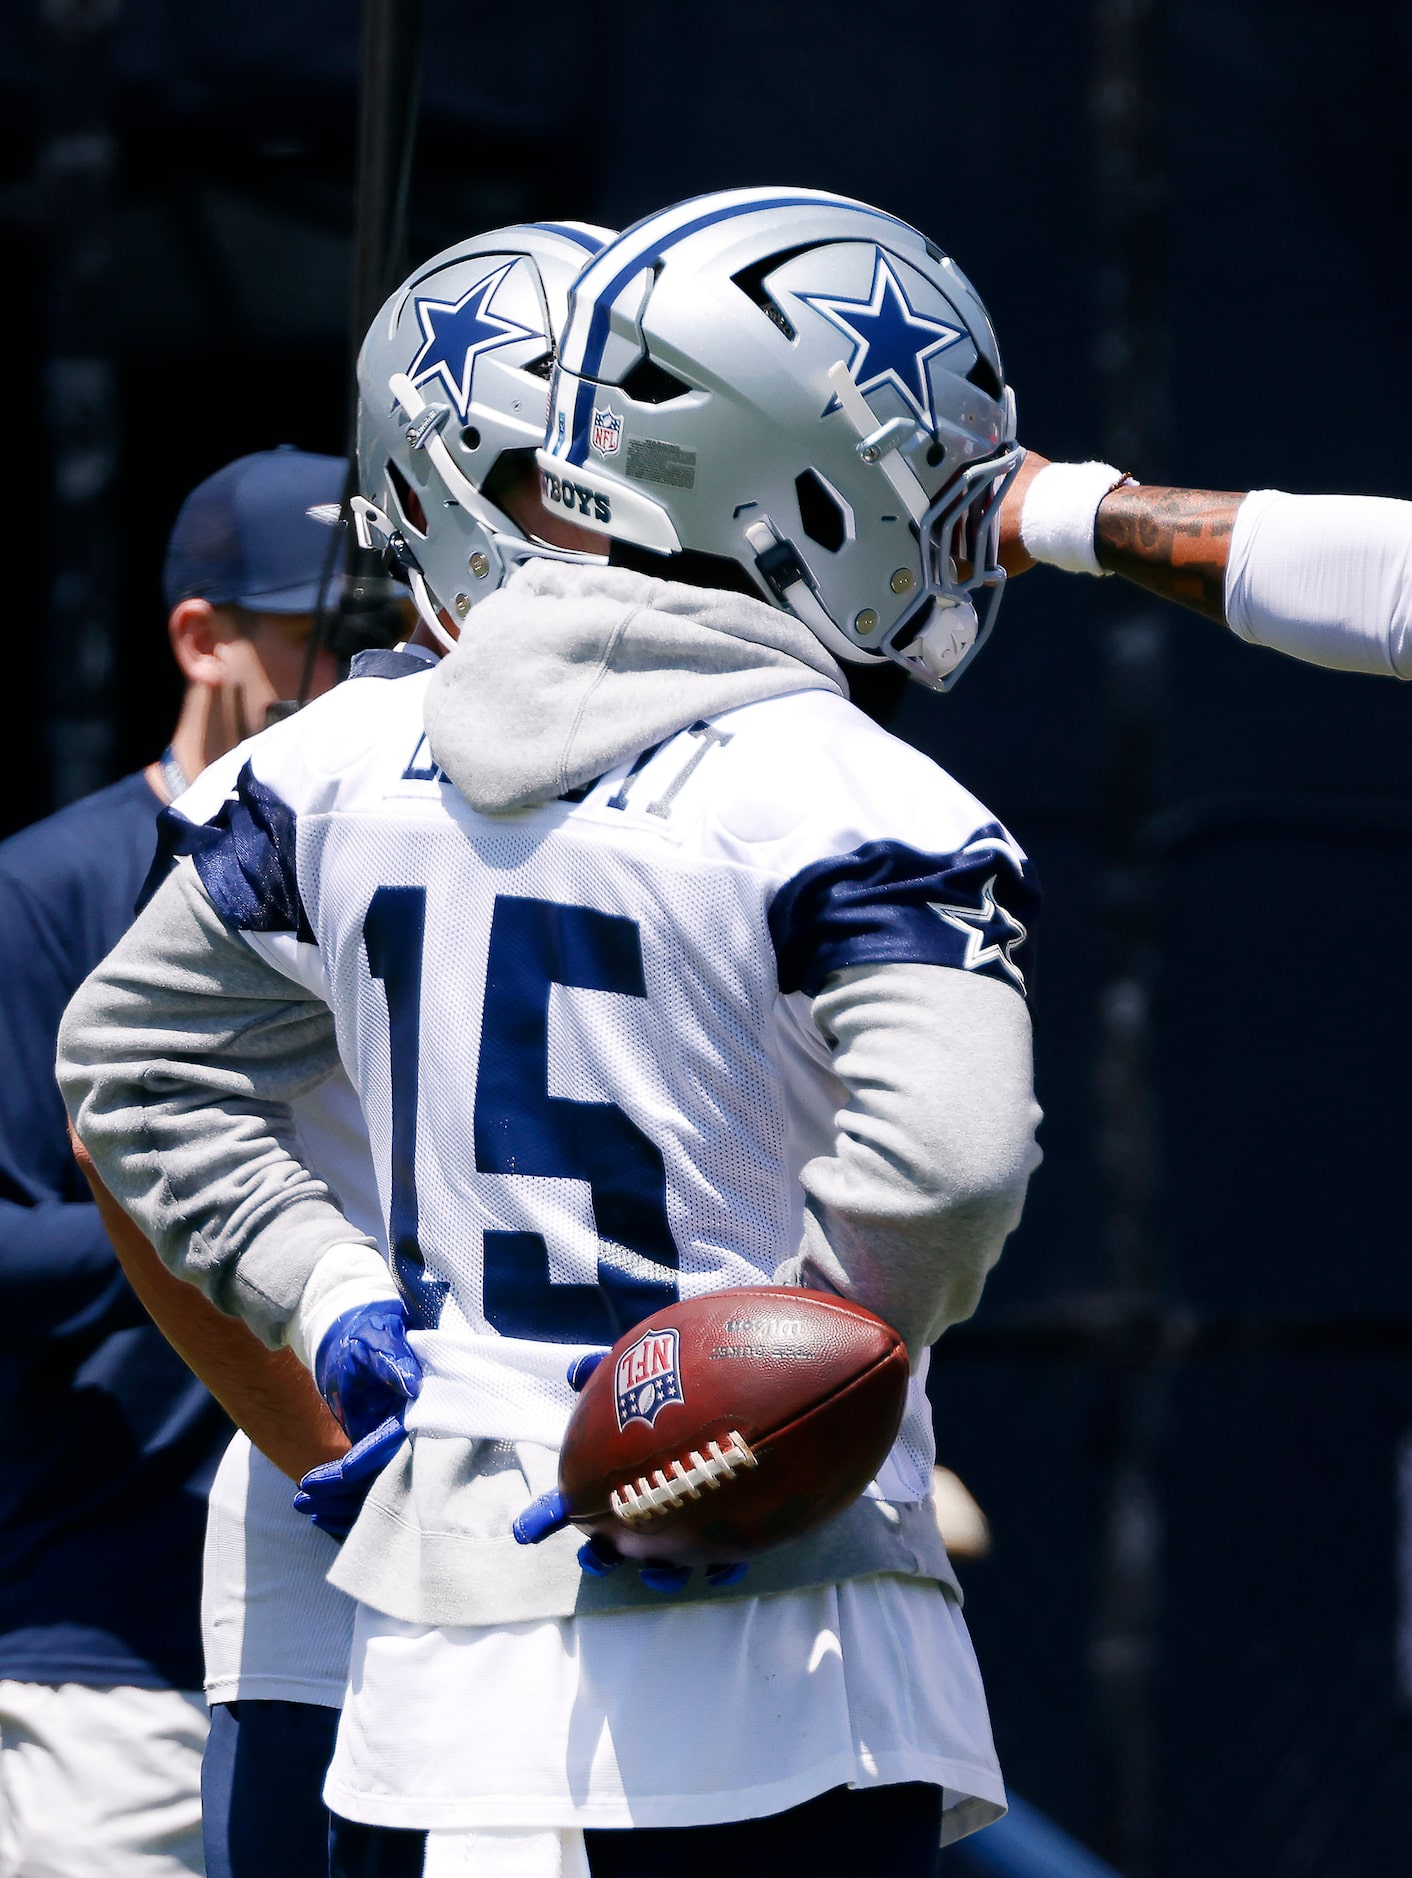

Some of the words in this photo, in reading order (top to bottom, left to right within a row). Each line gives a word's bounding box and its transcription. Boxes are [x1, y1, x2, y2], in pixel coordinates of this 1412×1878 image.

[594, 427, 616, 450] NFL
[363, 885, 680, 1348] 15
[622, 1337, 671, 1389] NFL
